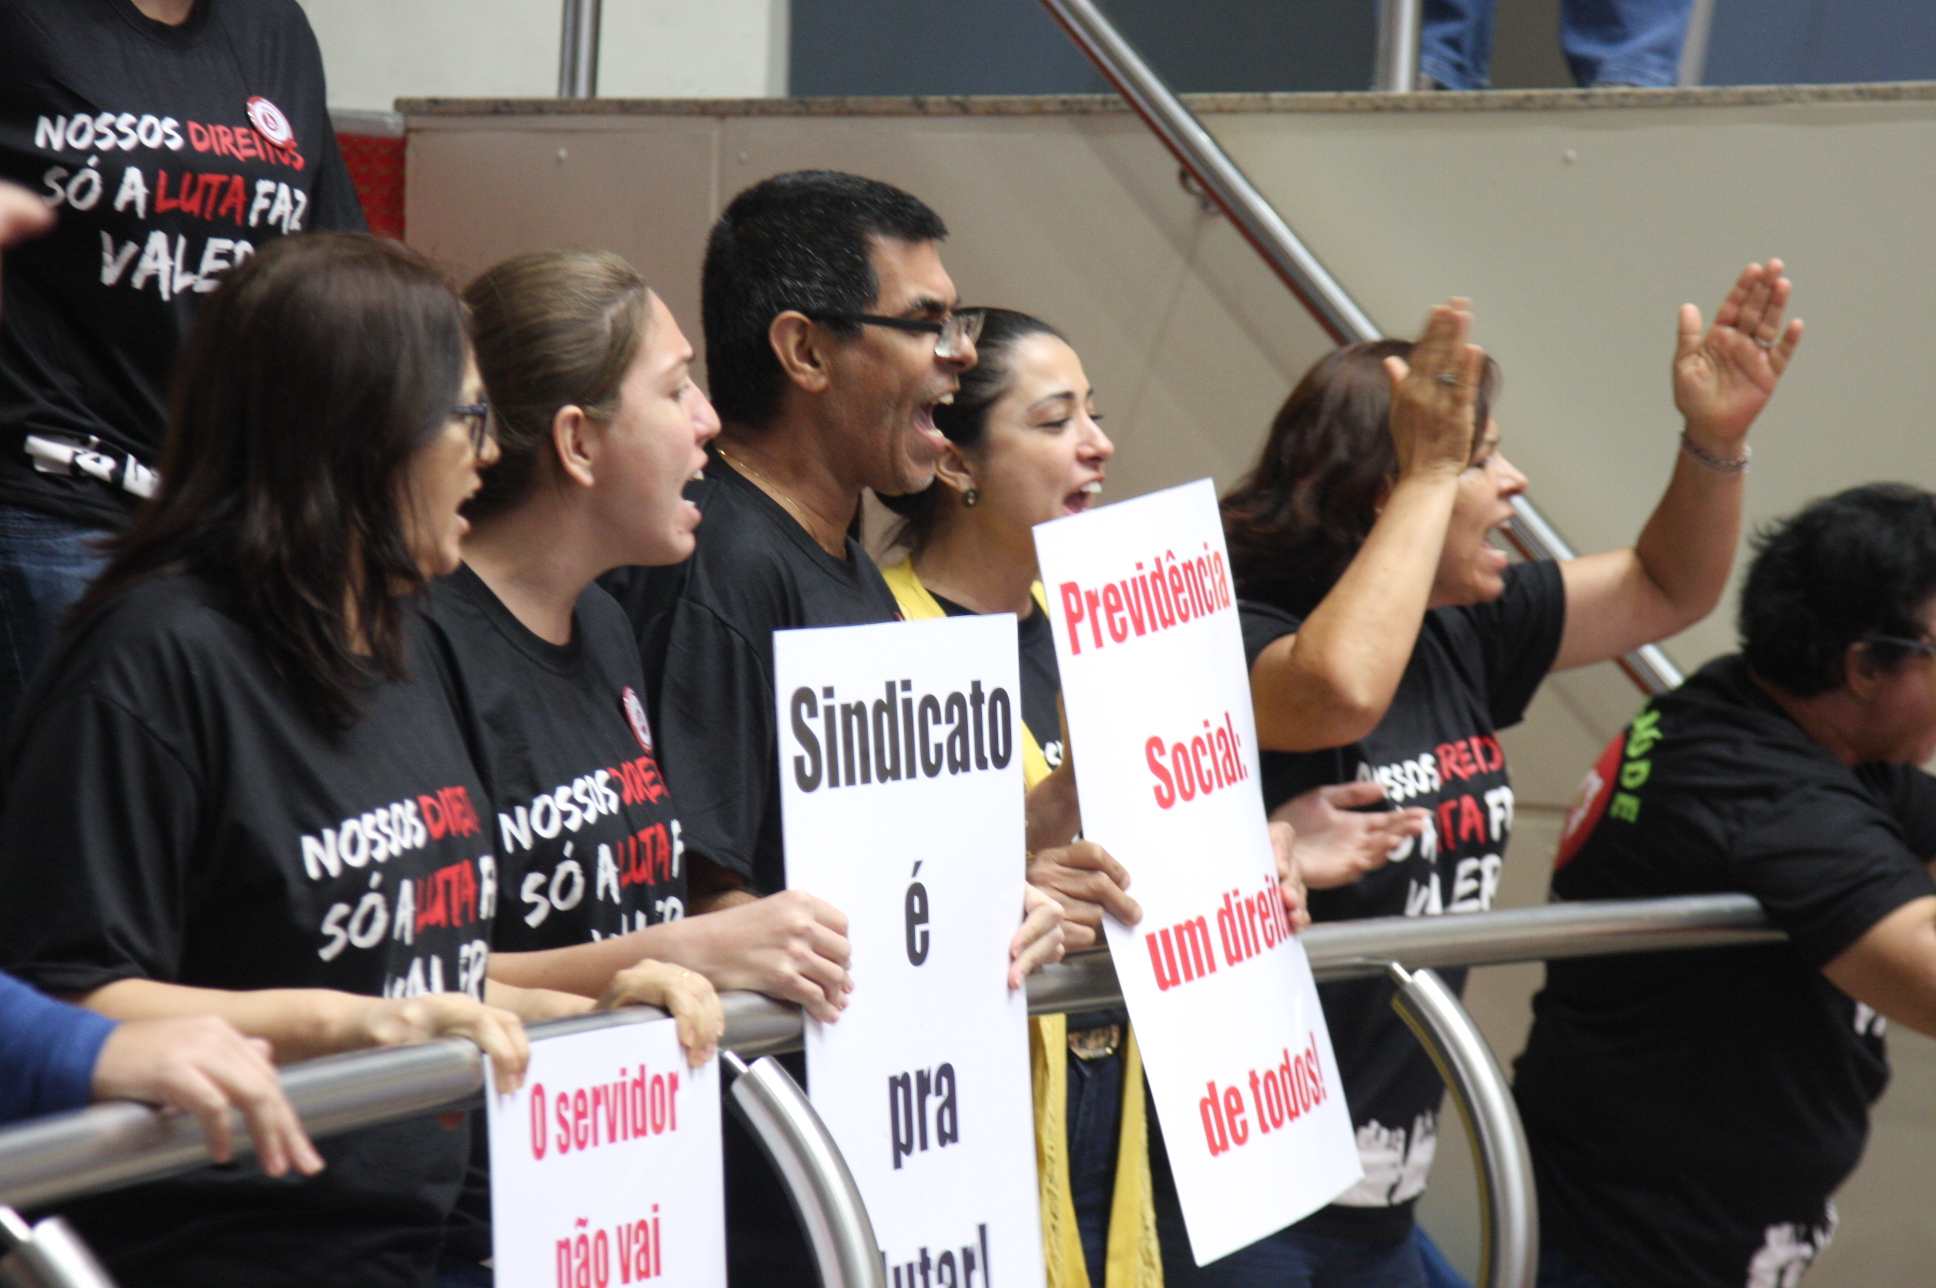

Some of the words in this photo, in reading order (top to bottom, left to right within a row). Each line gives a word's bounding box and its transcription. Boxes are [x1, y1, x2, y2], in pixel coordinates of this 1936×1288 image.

[35, 113, 184, 152] NOSSOS
[42, 156, 103, 211] SÓ
[114, 166, 150, 219] A
[154, 169, 248, 226] LUTA
[1059, 542, 1231, 656] Previdência
[791, 679, 1013, 793] Sindicato
[1145, 711, 1249, 810] Social:
[301, 798, 428, 880] NOSSOS
[499, 768, 619, 853] NOSSOS
[318, 871, 390, 962] SÓ
[393, 879, 416, 945] A
[414, 859, 478, 933] LUTA
[520, 841, 585, 928] SÓ
[596, 842, 620, 905] A
[617, 822, 672, 887] LUTA
[905, 860, 930, 967] é
[1145, 914, 1217, 991] um
[531, 1082, 547, 1161] O
[556, 1063, 680, 1154] servidor
[889, 1062, 959, 1170] pra
[1199, 1080, 1249, 1157] de
[1248, 1030, 1327, 1135] todos!
[556, 1217, 608, 1288] não
[616, 1203, 661, 1285] vai
